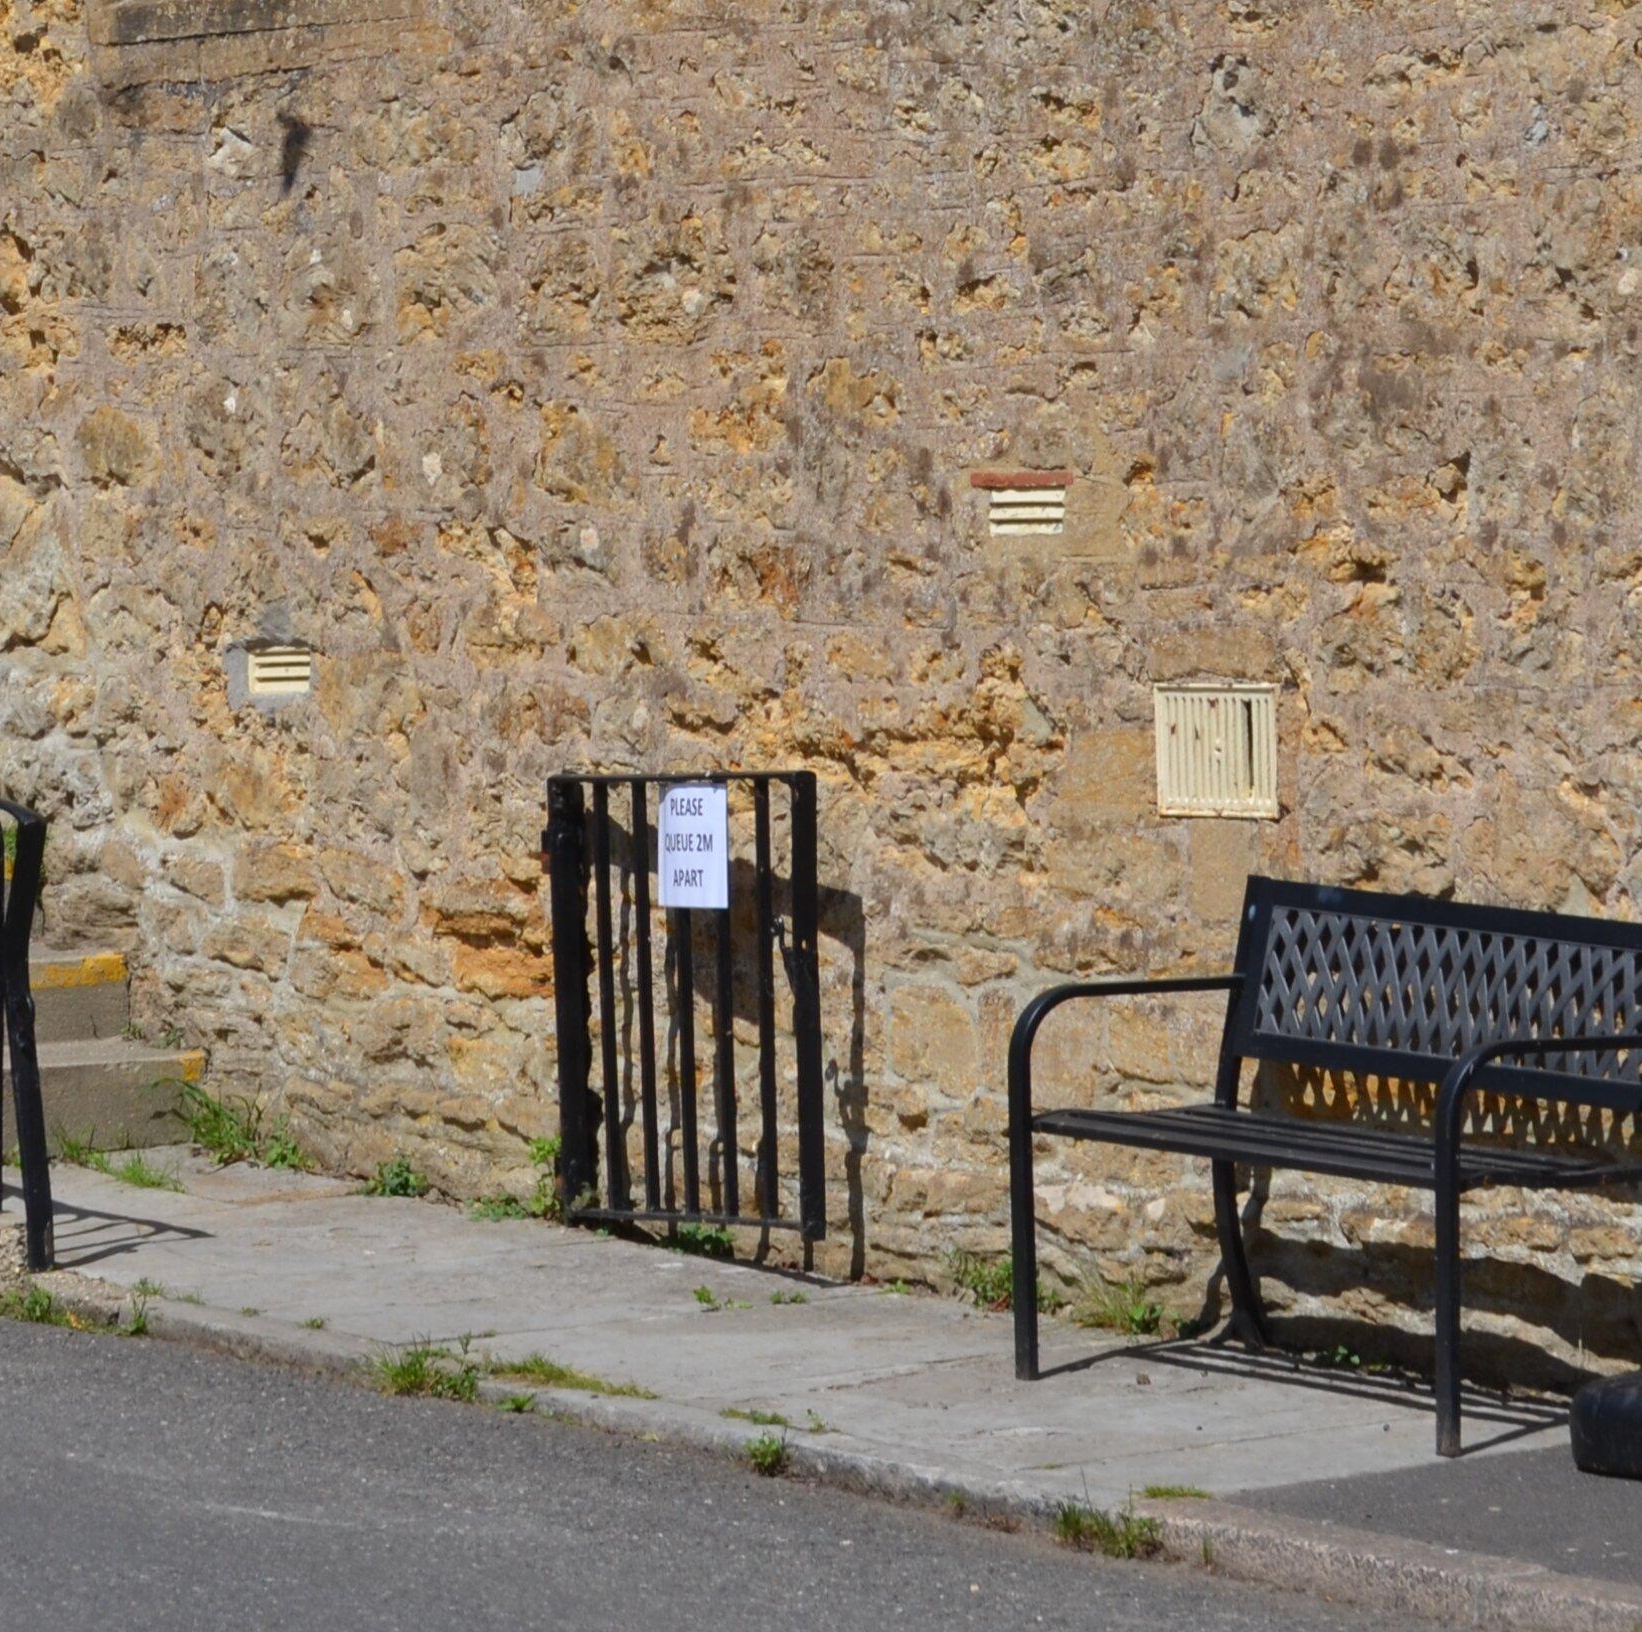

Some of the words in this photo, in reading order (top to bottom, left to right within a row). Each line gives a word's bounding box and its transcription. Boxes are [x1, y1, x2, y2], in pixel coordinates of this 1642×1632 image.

[670, 797, 704, 817] PLEASE
[664, 833, 694, 853] QUEUE
[697, 833, 713, 853] 2M
[672, 869, 704, 887] APART
